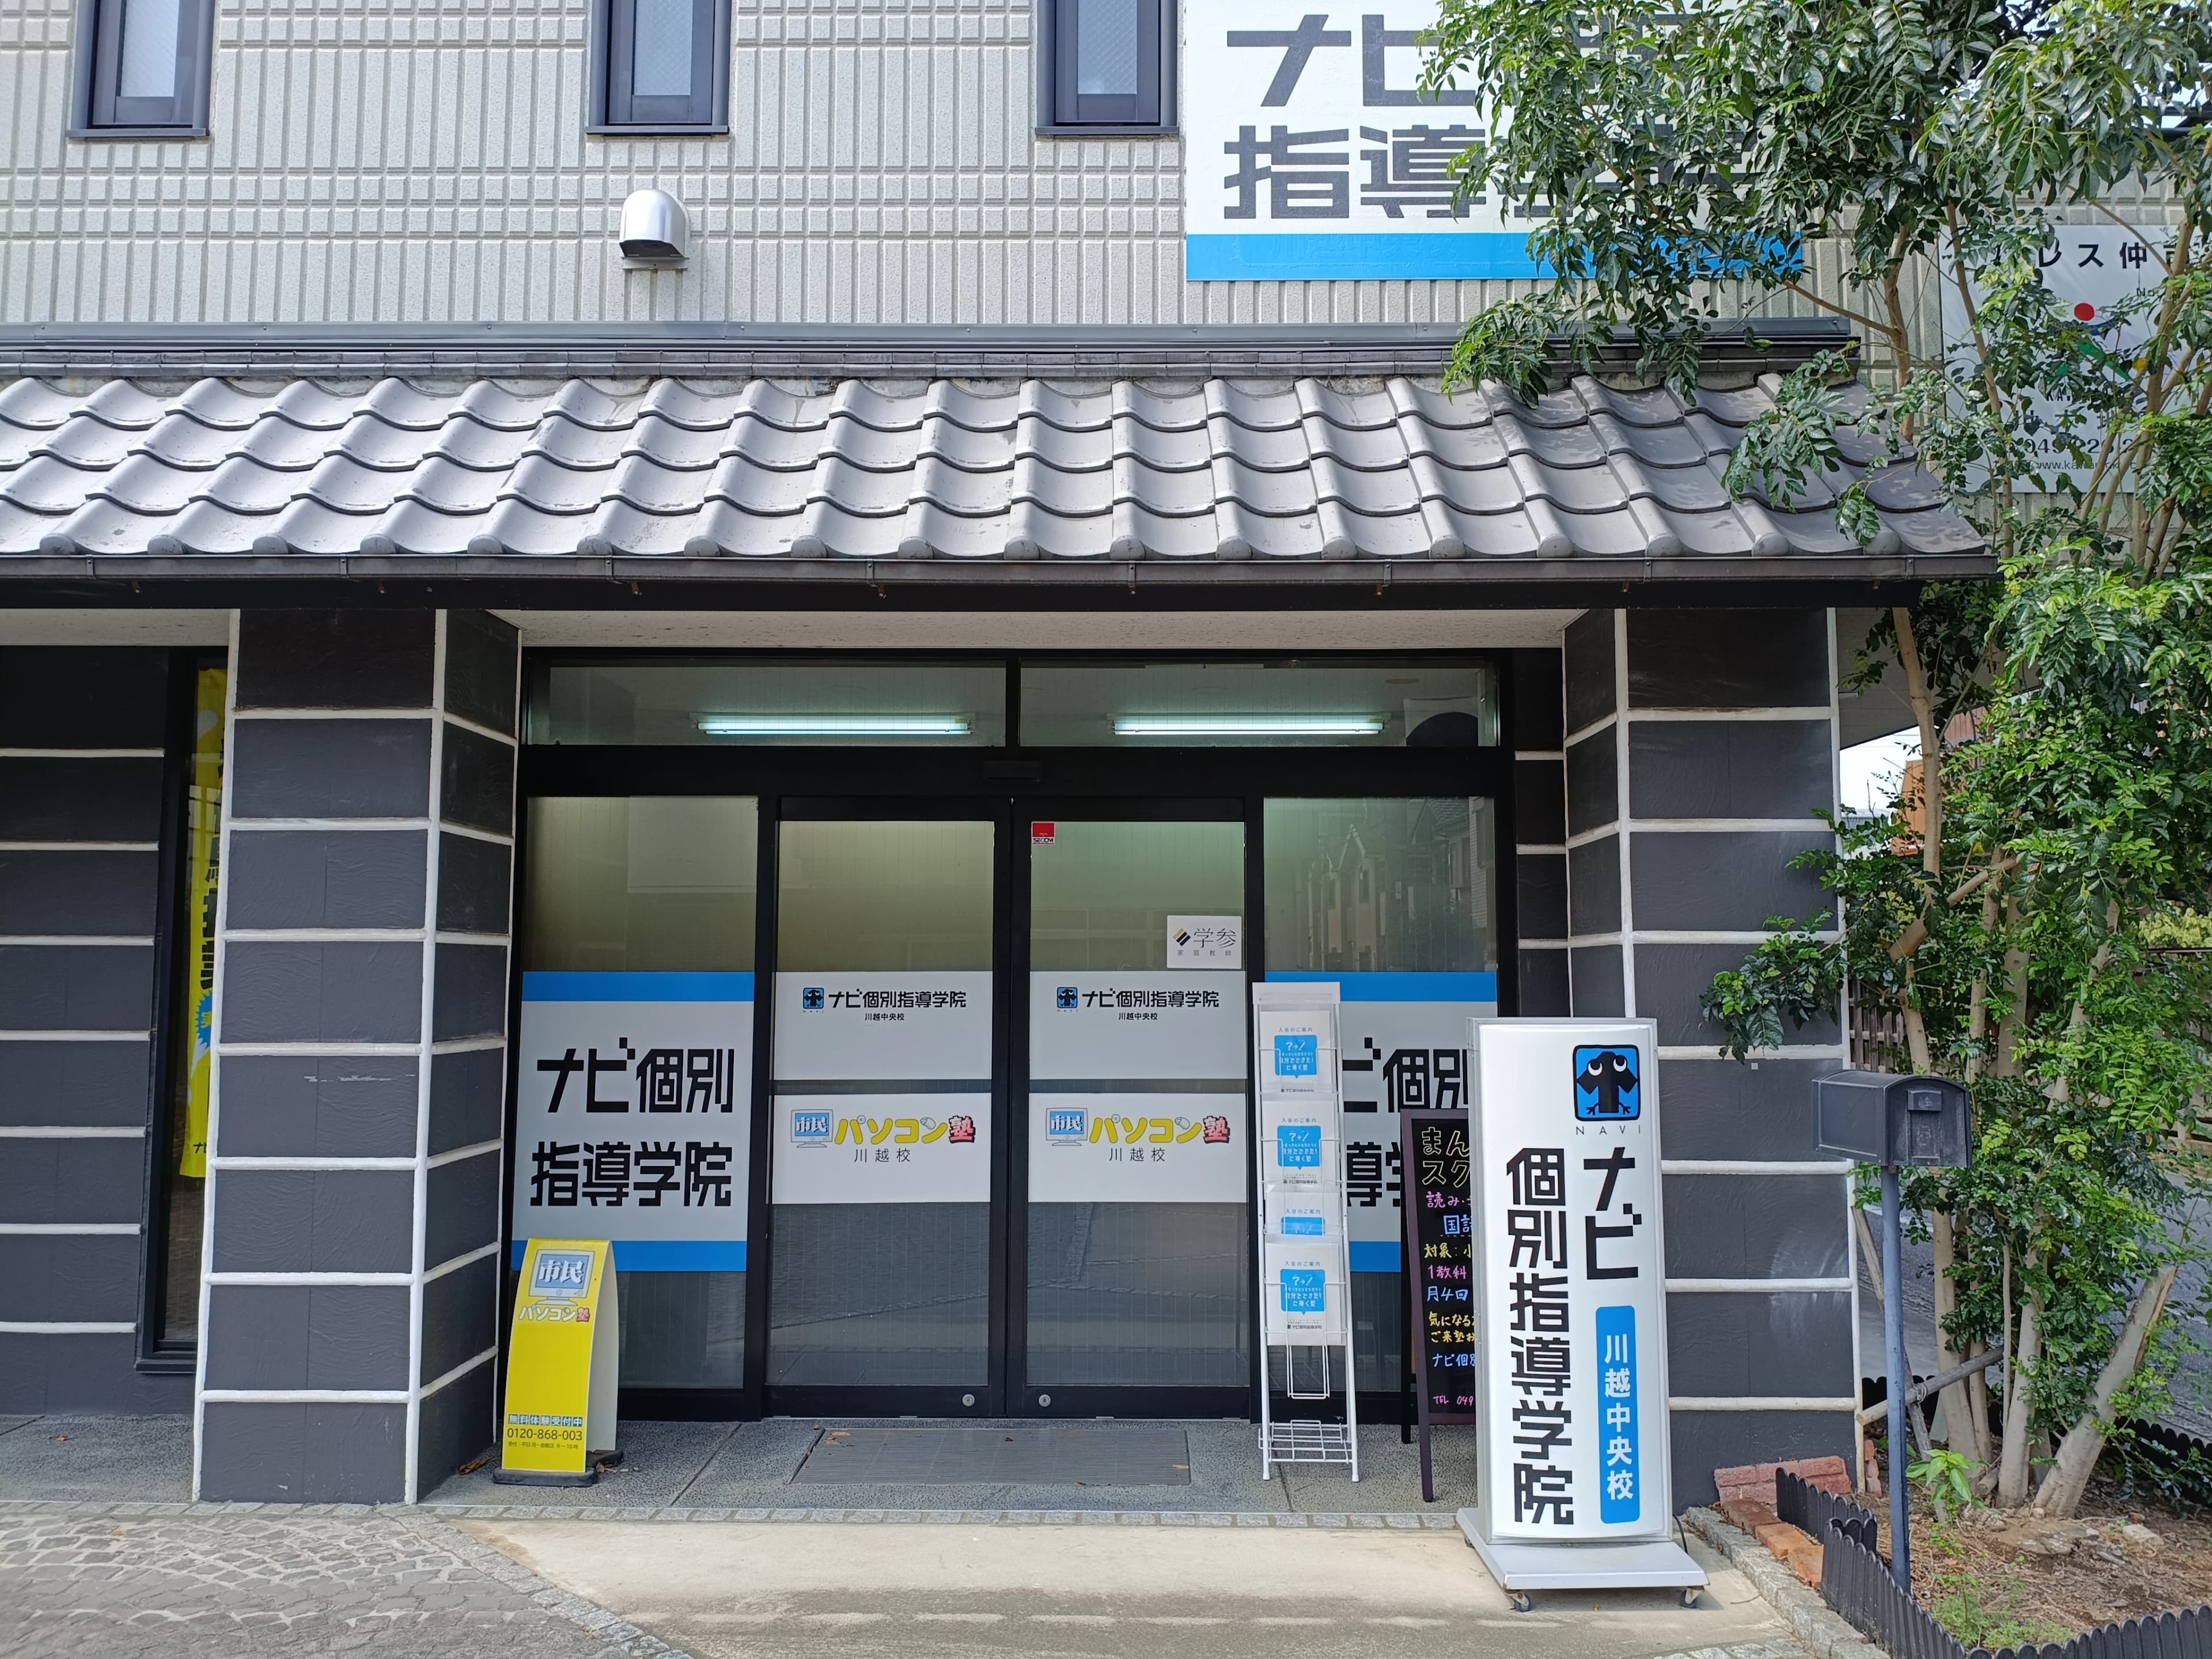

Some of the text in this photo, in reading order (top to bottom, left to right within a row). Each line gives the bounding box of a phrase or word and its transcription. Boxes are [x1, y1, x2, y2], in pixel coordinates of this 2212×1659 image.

[1194, 928, 1236, 948] 学参
[828, 988, 967, 1007] ナビ個別指導学院
[1082, 988, 1219, 1007] ナビ個別指導学院
[865, 1013, 905, 1021] 川越中央校
[1118, 1012, 1158, 1020] 川越中央校
[537, 1037, 734, 1113] ナビ個別
[796, 1115, 975, 1145] 市民 パソコン塾
[1051, 1114, 1230, 1144] 市民 パソコン塾
[1576, 1124, 1641, 1135] NAVI
[1422, 1127, 1469, 1157] まん
[854, 1148, 911, 1162] 川越校
[1109, 1147, 1165, 1162] 川越校
[529, 1141, 732, 1207] 指導学院
[1346, 1142, 1400, 1207] 導
[1422, 1160, 1470, 1188] スク
[1426, 1191, 1472, 1208] 読み・
[1584, 1147, 1642, 1280] ナビ
[539, 1260, 585, 1283] 市民
[1428, 1265, 1467, 1279] 1教科
[1427, 1286, 1468, 1302] 月4回
[519, 1305, 590, 1323] パソコン塾
[1506, 1148, 1574, 1525] 個別指導学院
[1433, 1395, 1449, 1404] TEL
[509, 1414, 583, 1427] 無料体験受付中
[1604, 1334, 1634, 1500] 川越中央校
[507, 1427, 582, 1441] 0120-868-003
